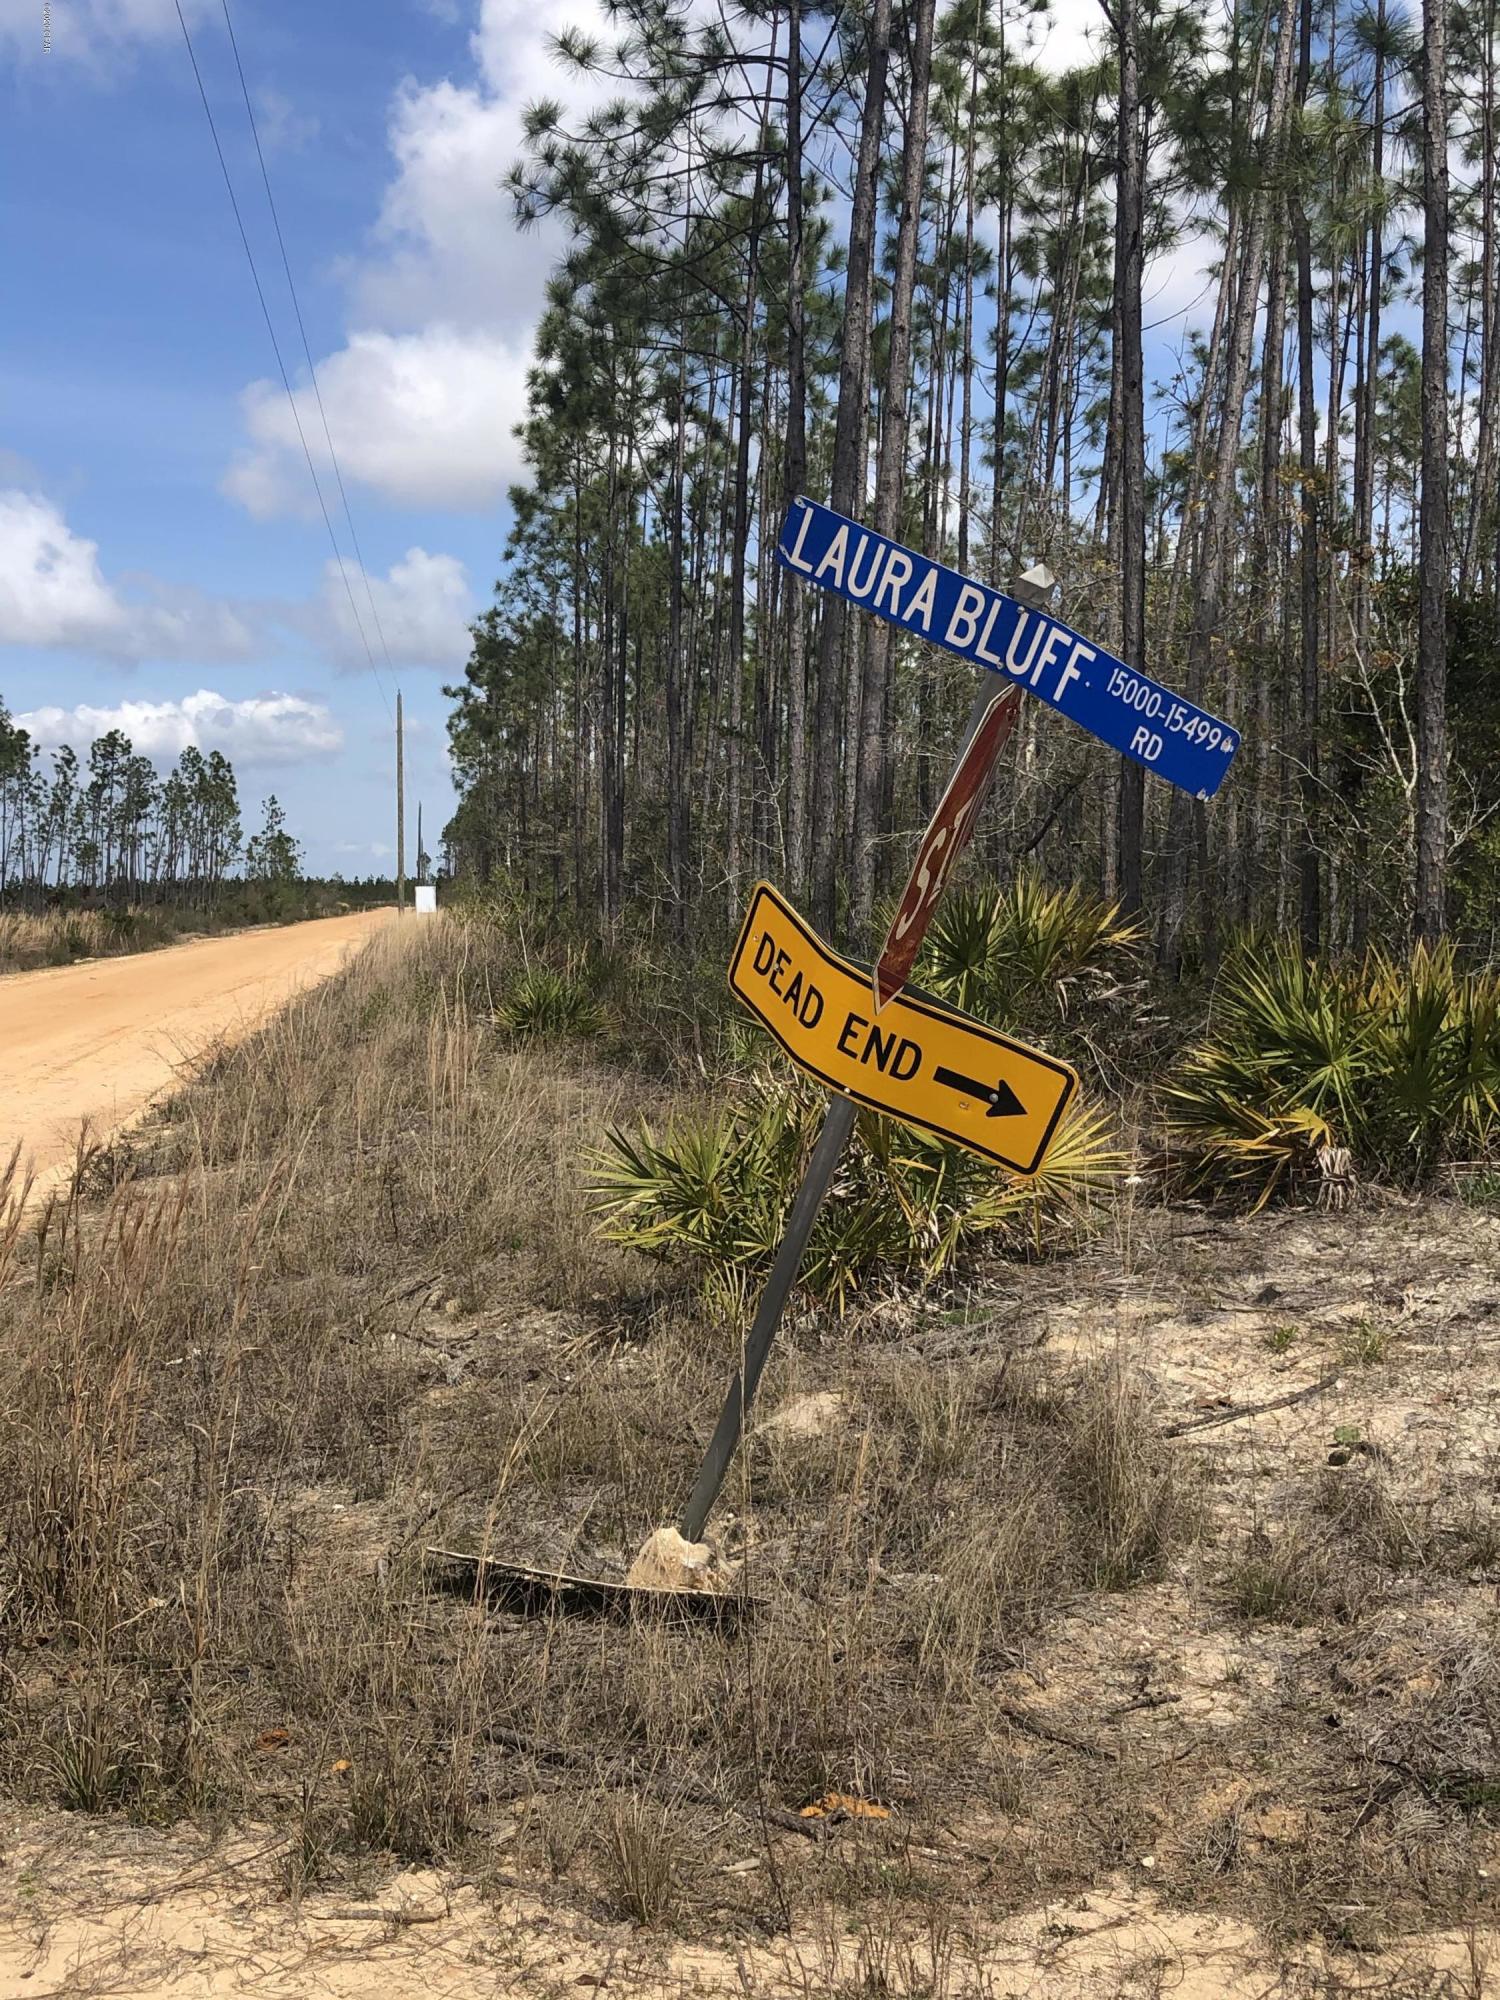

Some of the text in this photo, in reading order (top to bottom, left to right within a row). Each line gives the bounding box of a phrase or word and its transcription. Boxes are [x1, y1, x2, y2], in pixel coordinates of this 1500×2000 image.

[790, 508, 1096, 702] LAURA BLUFF
[1106, 667, 1222, 751] 15000-15499
[1130, 726, 1163, 761] RD
[752, 931, 923, 1081] DEAD END
